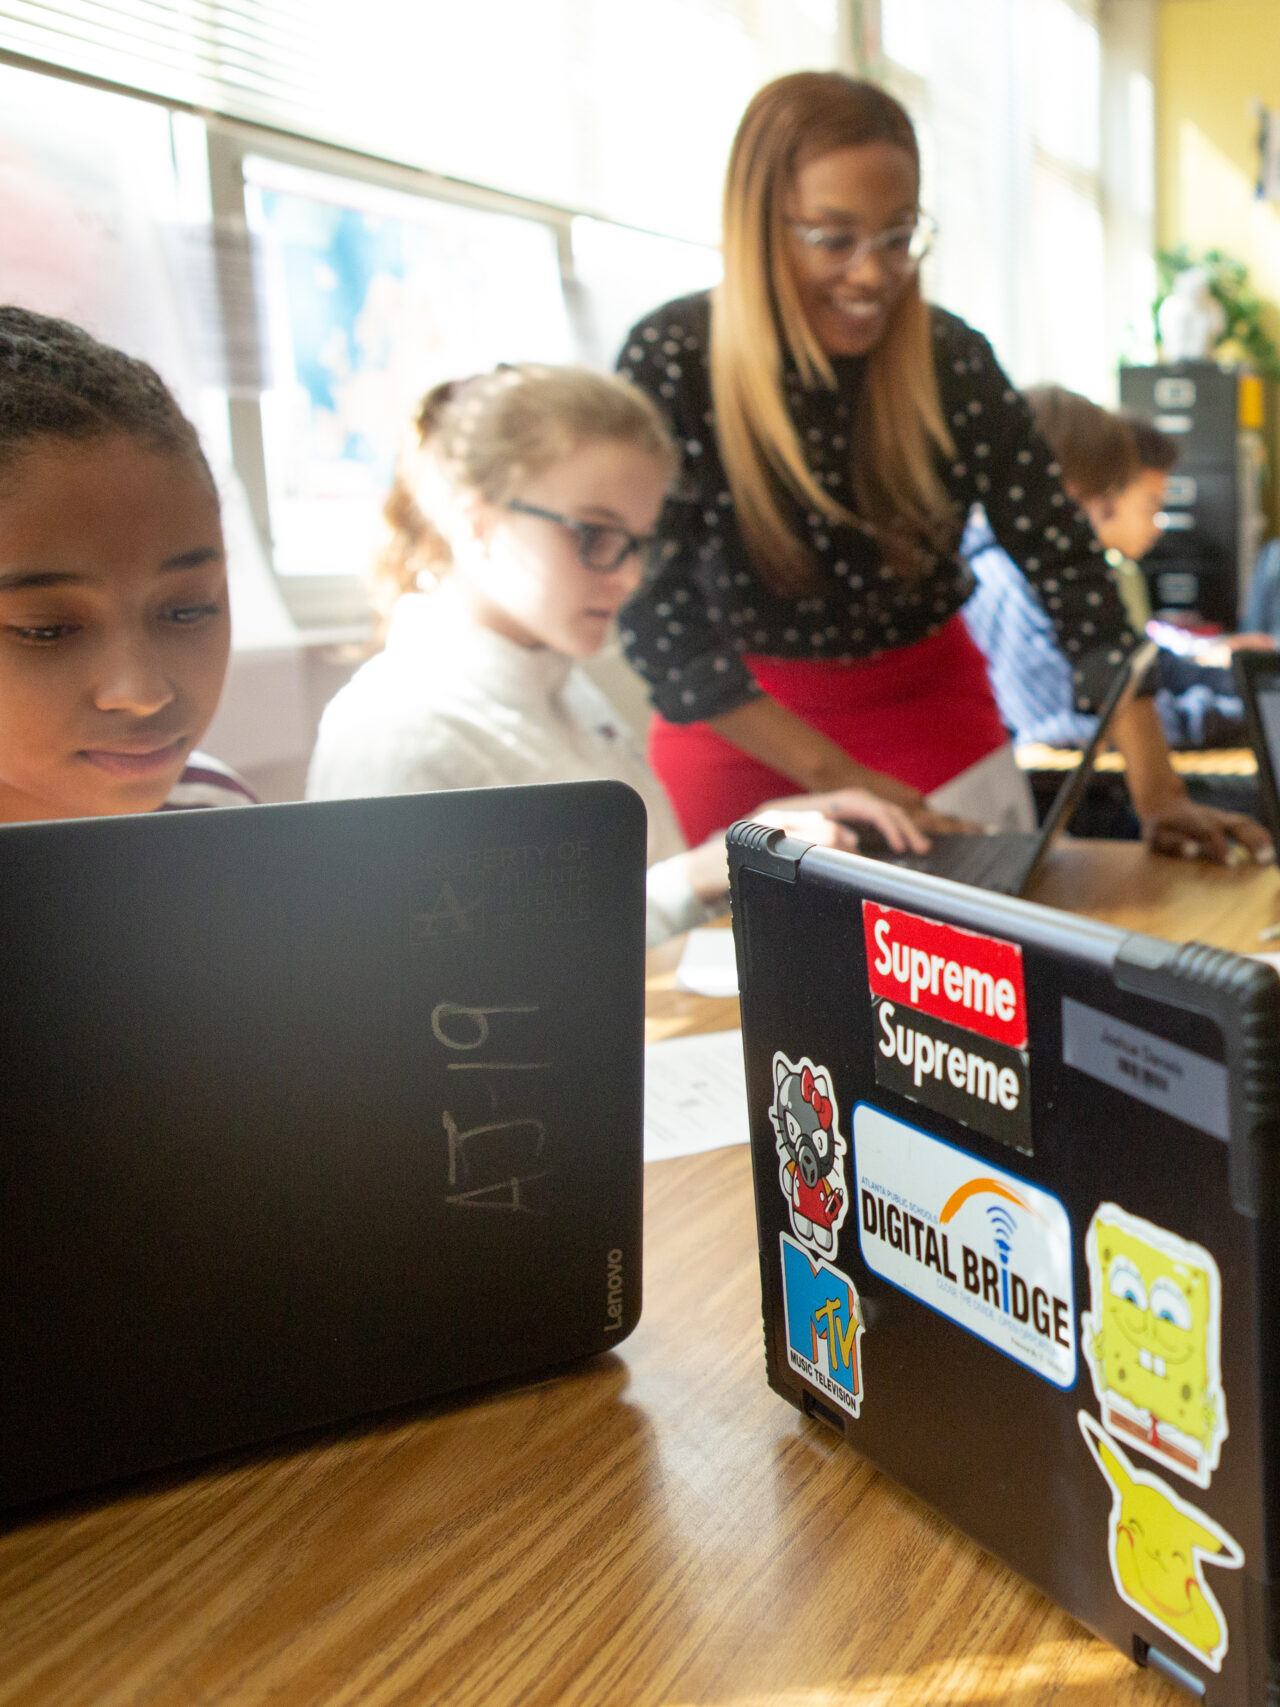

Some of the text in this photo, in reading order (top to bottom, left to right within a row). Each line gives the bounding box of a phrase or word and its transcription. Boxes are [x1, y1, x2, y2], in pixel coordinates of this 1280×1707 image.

[499, 865, 591, 888] ATLANTA
[556, 839, 591, 861] OF
[873, 918, 1017, 1023] Supreme
[878, 1000, 1021, 1112] Supreme
[861, 1188, 958, 1284] DIGITAL
[604, 1248, 624, 1332] Lenovo
[783, 1240, 860, 1395] MTV
[790, 1350, 857, 1412] MUSIC TELEVISION
